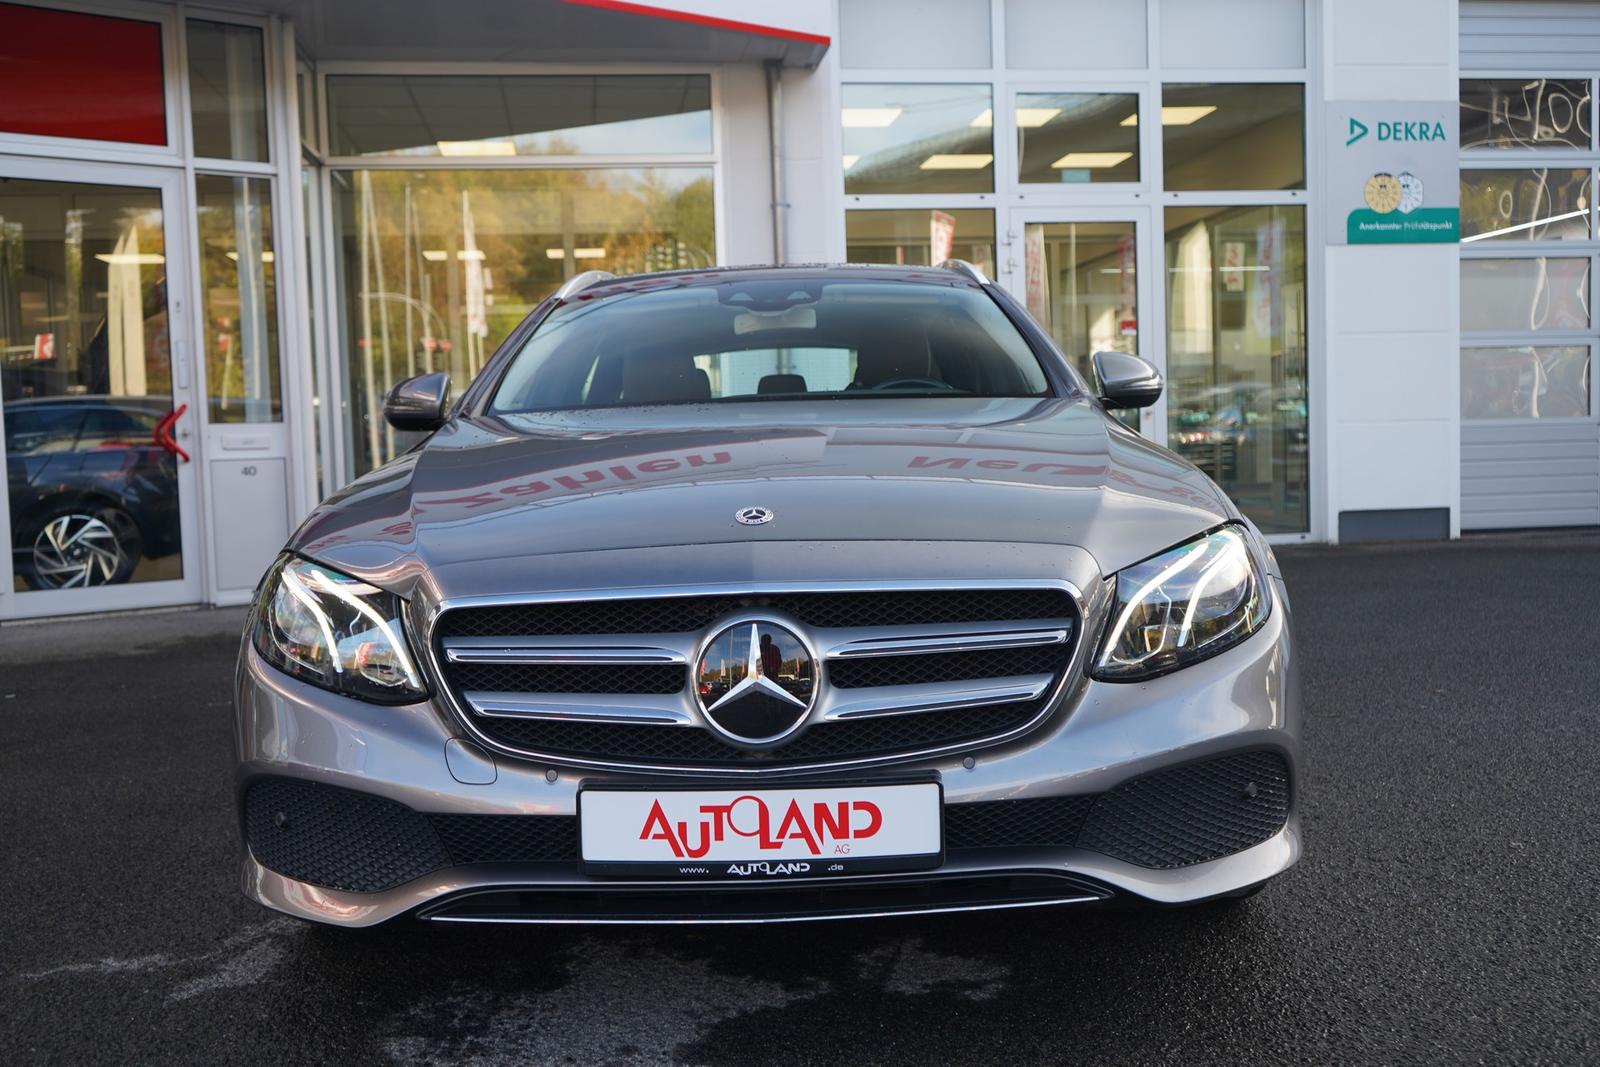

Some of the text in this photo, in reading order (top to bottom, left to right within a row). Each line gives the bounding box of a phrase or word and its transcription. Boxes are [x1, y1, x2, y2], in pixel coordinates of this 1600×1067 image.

[1377, 121, 1446, 141] DEKRA
[241, 465, 257, 477] 40
[639, 795, 883, 859] AUTOLAND
[833, 844, 851, 855] AG
[827, 863, 844, 871] .de
